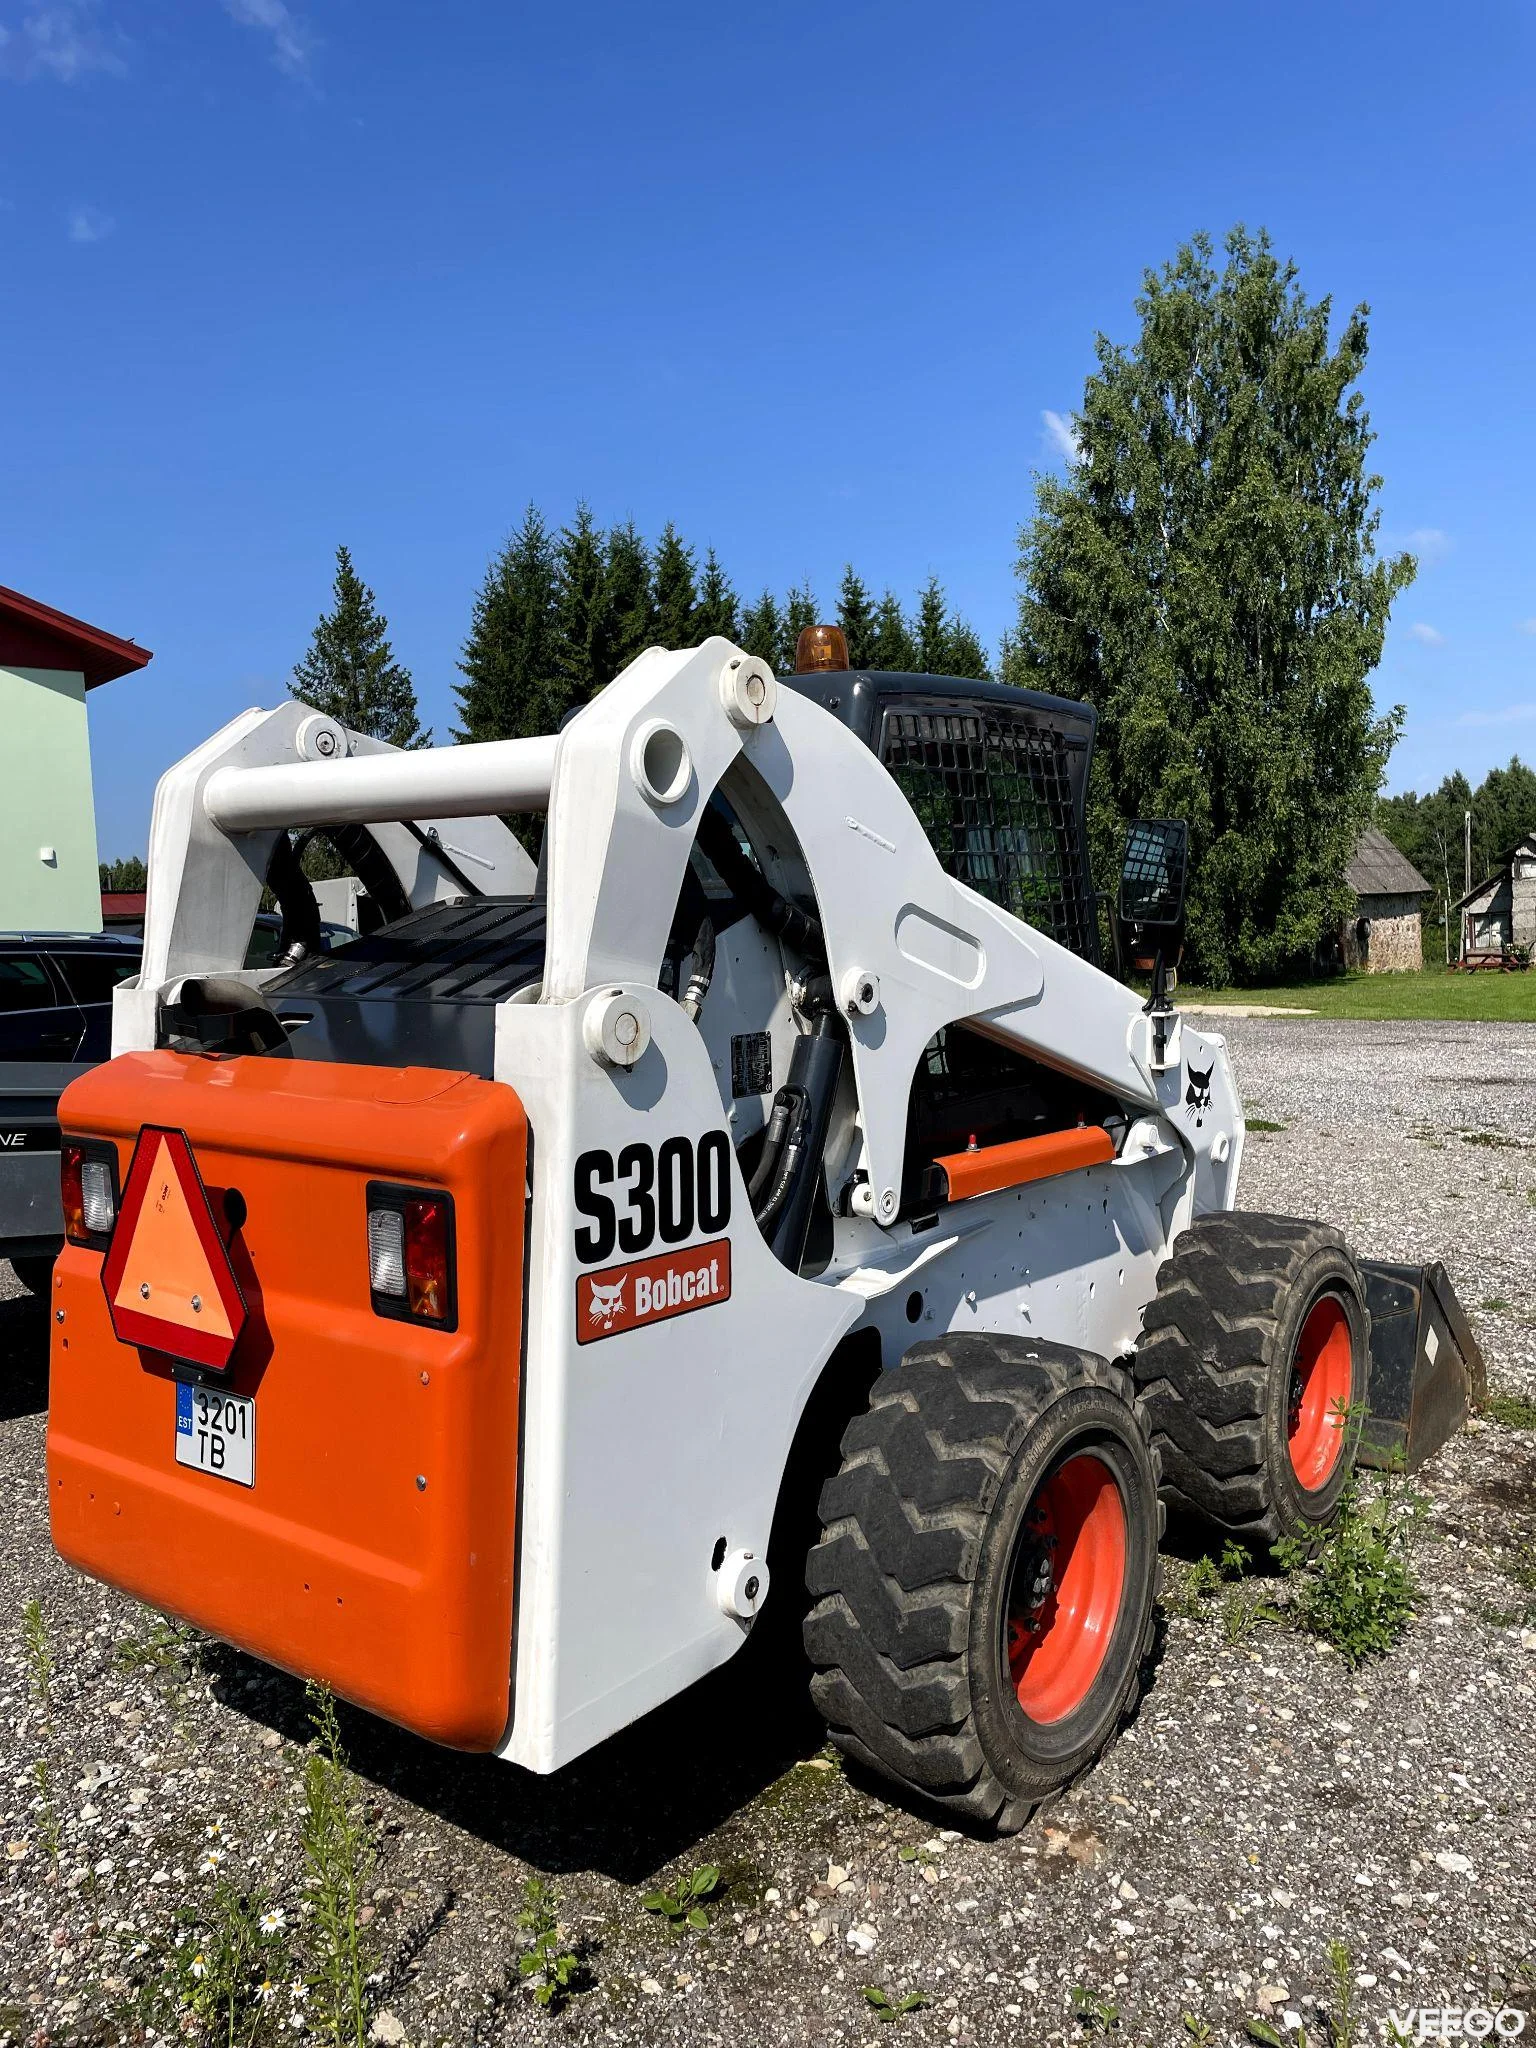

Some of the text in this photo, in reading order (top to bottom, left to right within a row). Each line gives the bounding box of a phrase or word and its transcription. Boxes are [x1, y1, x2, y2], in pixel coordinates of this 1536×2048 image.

[574, 1130, 732, 1264] S300
[635, 1259, 719, 1316] Bobcat
[178, 1415, 192, 1430] EST
[198, 1393, 246, 1440] 3201
[197, 1429, 226, 1470] TB
